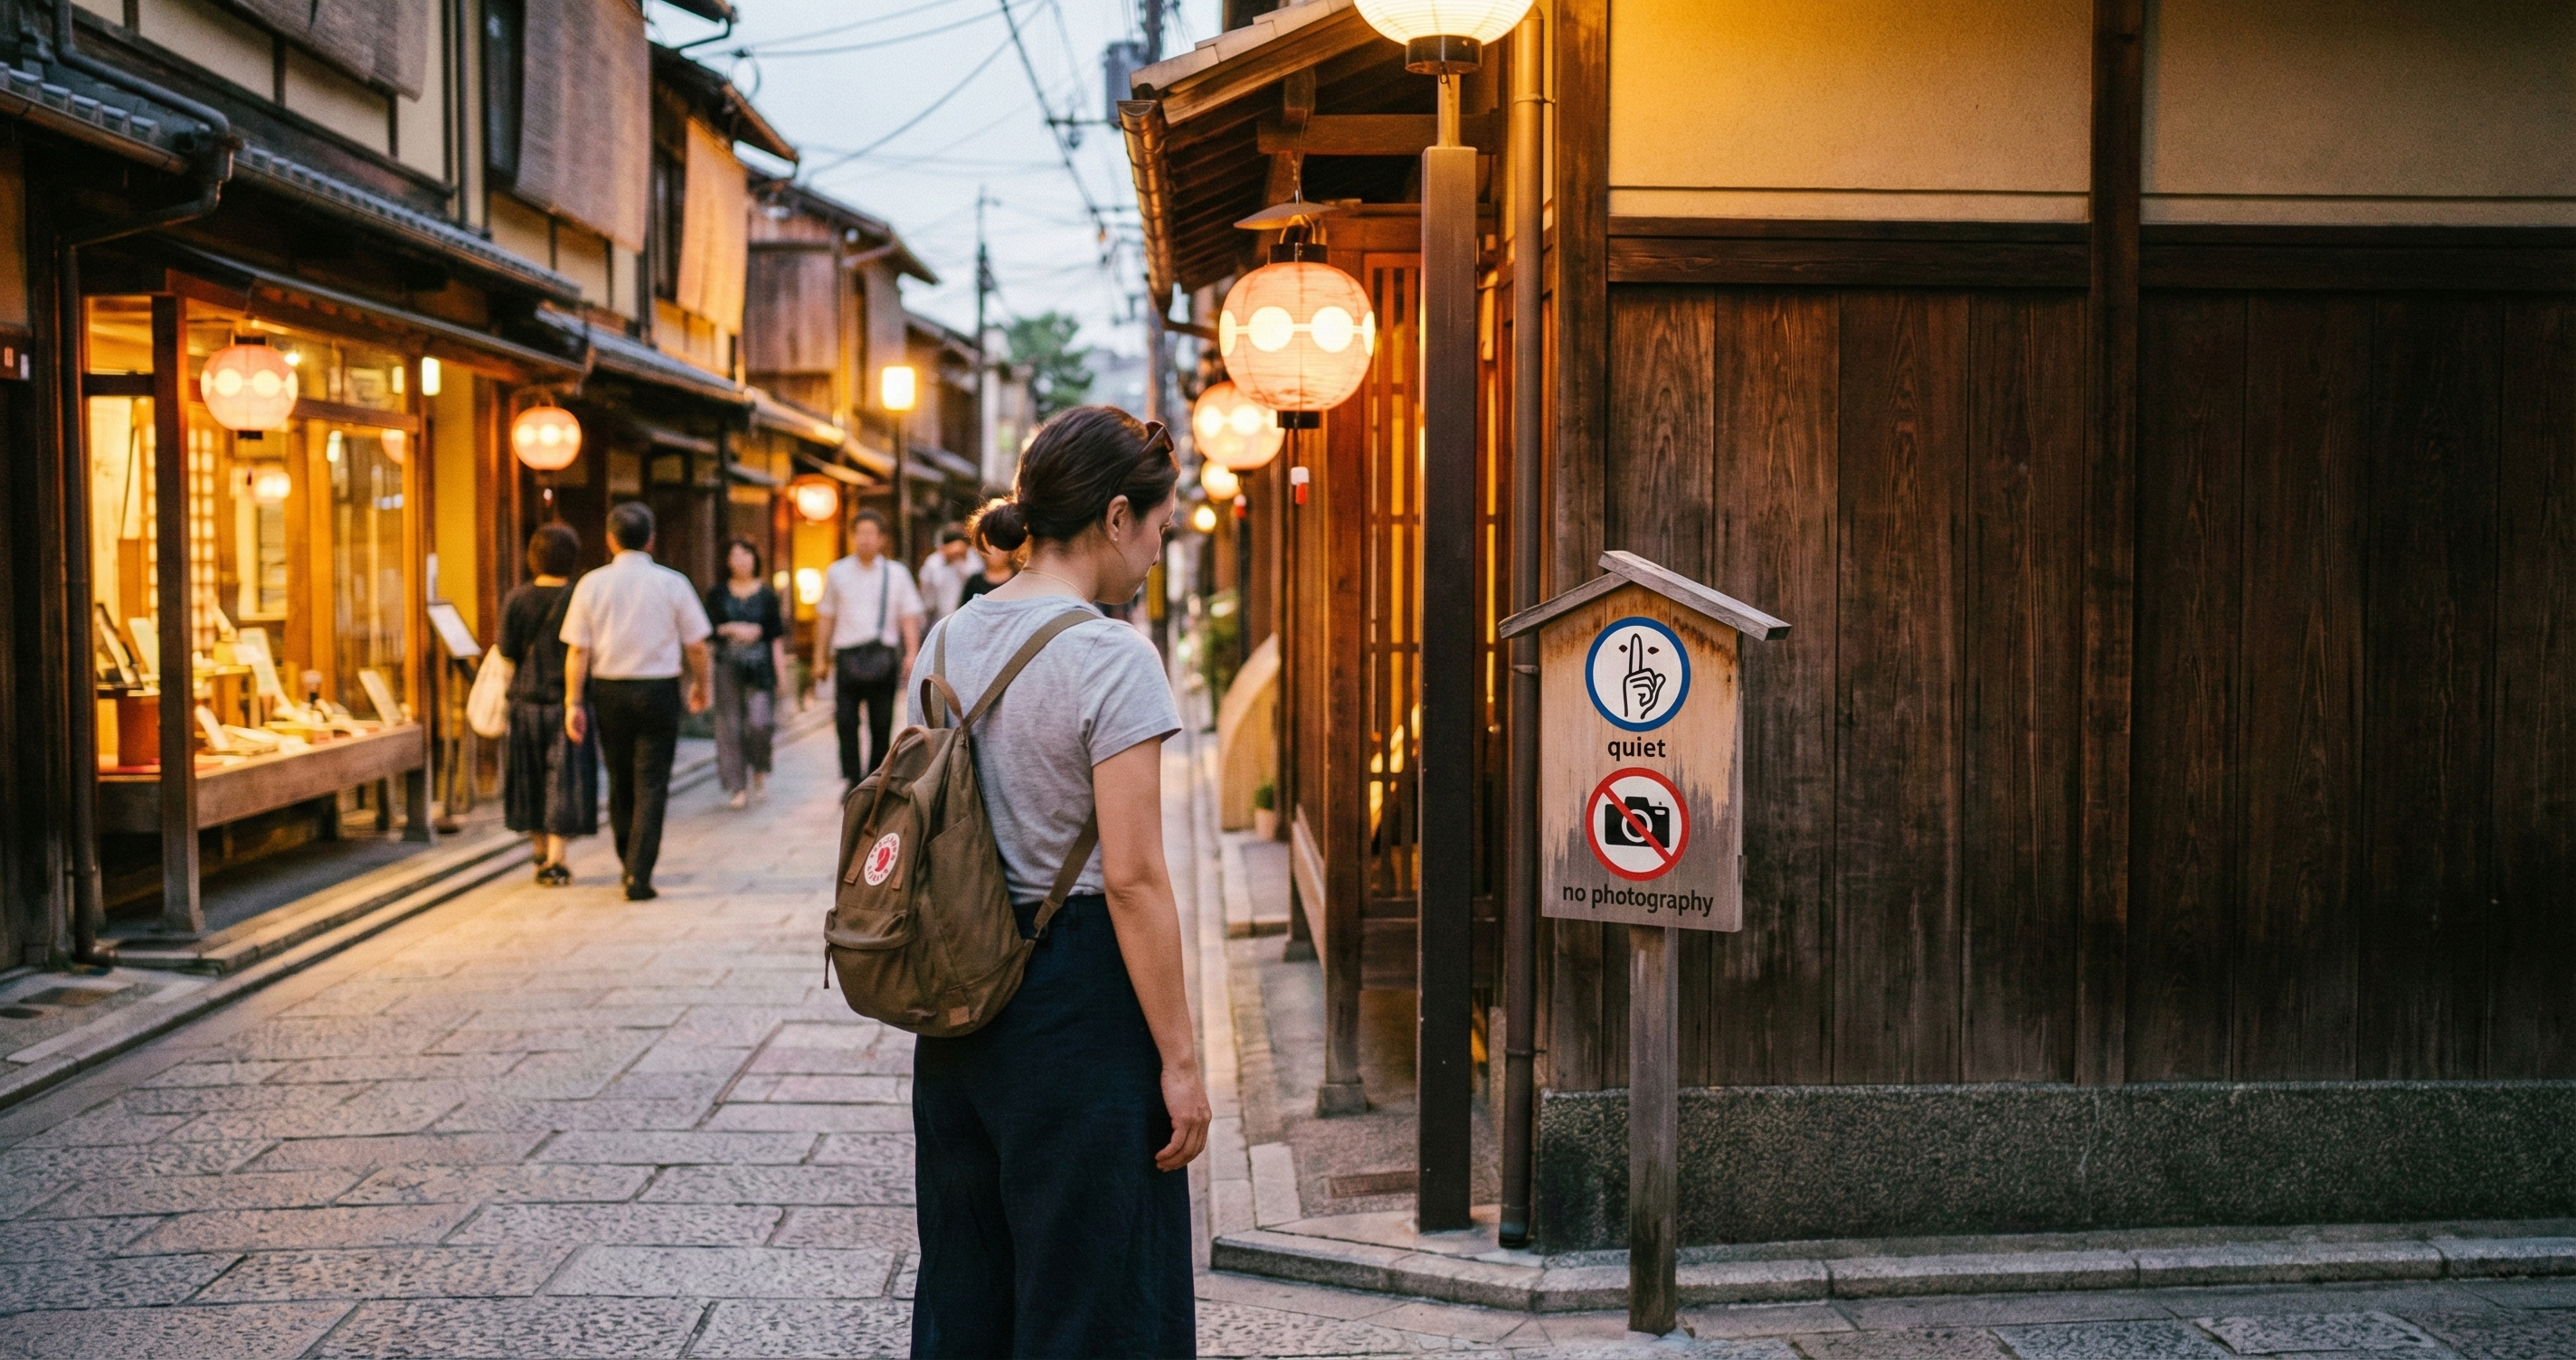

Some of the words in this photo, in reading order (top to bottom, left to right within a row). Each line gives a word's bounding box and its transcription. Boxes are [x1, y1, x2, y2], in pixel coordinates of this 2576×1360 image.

[1607, 736, 1666, 761] quiet
[1562, 885, 1586, 902] no
[1592, 883, 1714, 917] photography
